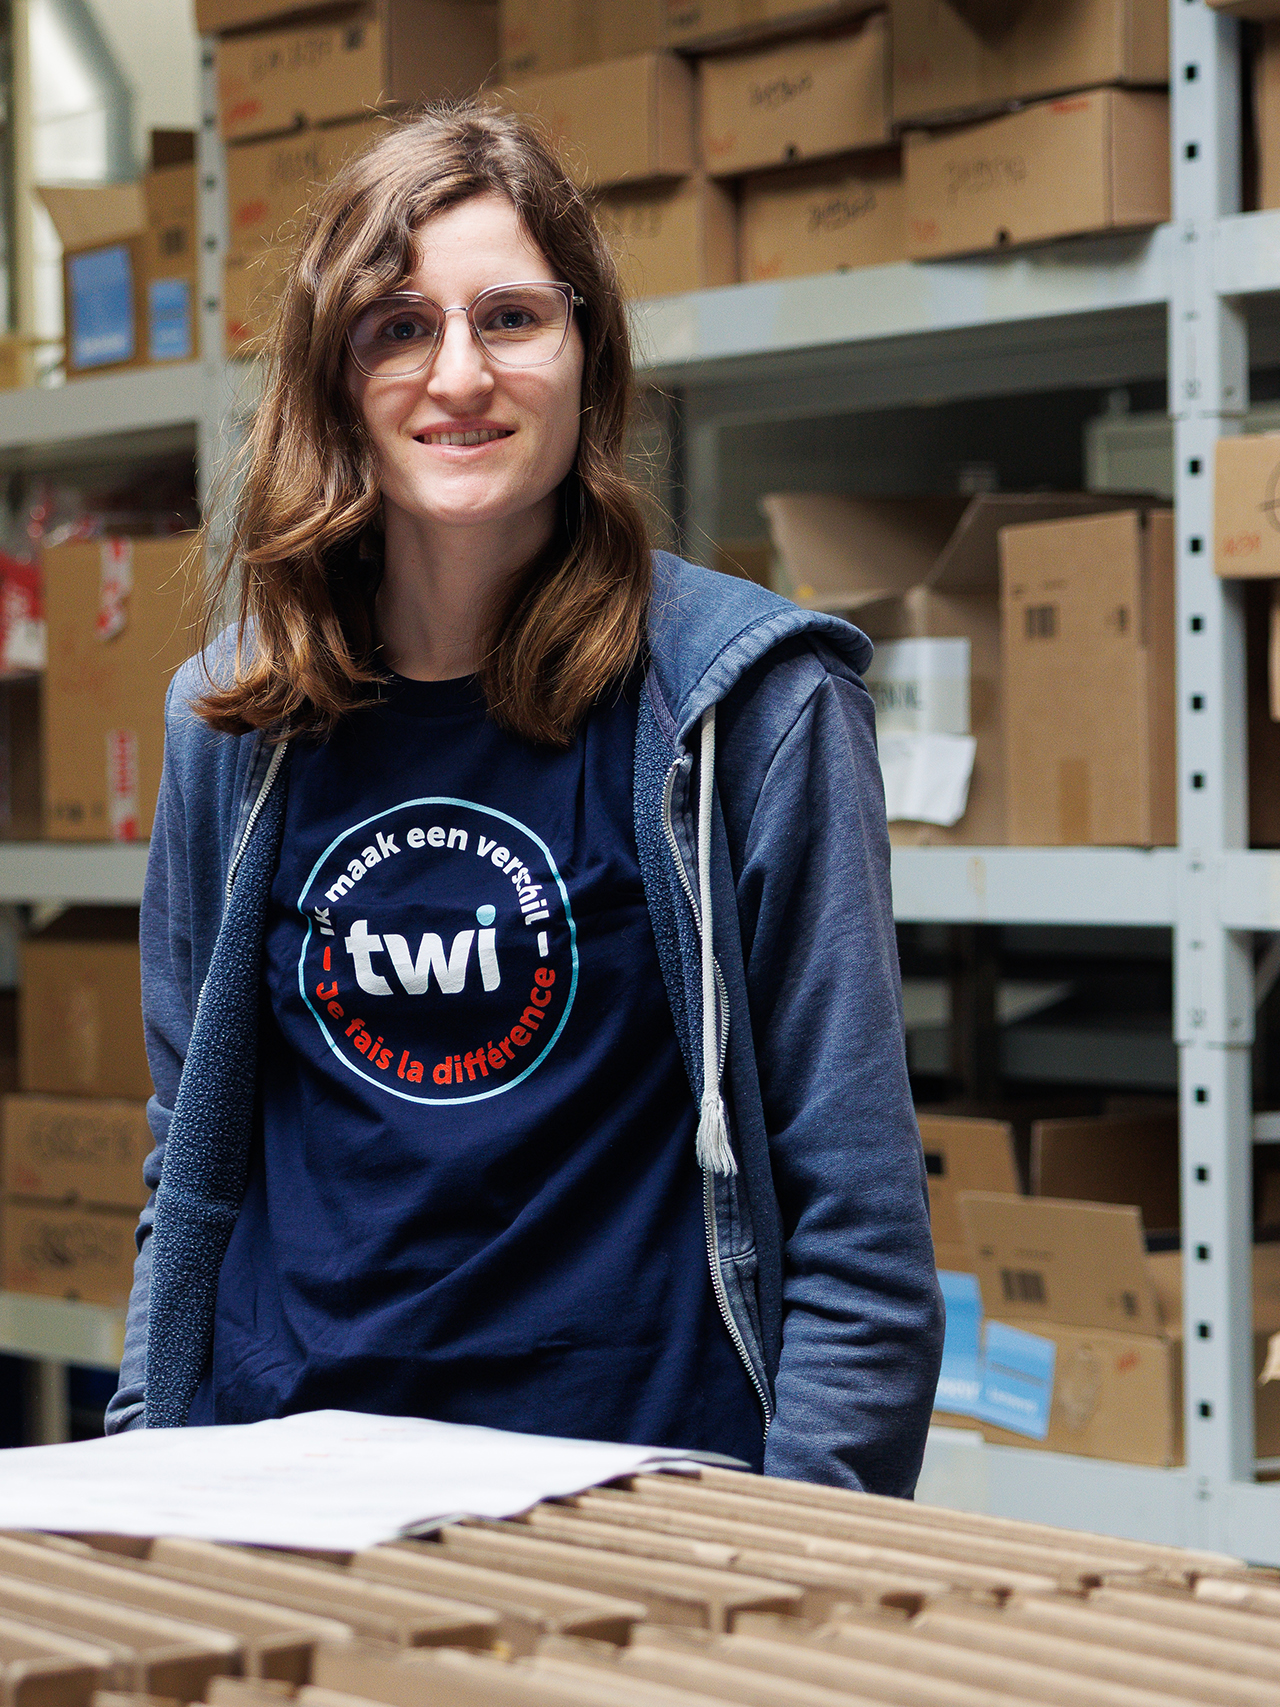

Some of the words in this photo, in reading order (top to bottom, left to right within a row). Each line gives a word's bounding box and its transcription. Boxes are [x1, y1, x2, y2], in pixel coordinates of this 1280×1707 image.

[324, 831, 402, 903] maak
[406, 826, 469, 851] een
[314, 905, 336, 936] Ik
[475, 834, 550, 926] verschil
[344, 904, 501, 996] twi
[315, 979, 345, 1020] Je
[344, 1017, 394, 1070] fais
[396, 1049, 425, 1084] la
[432, 966, 557, 1086] différence
